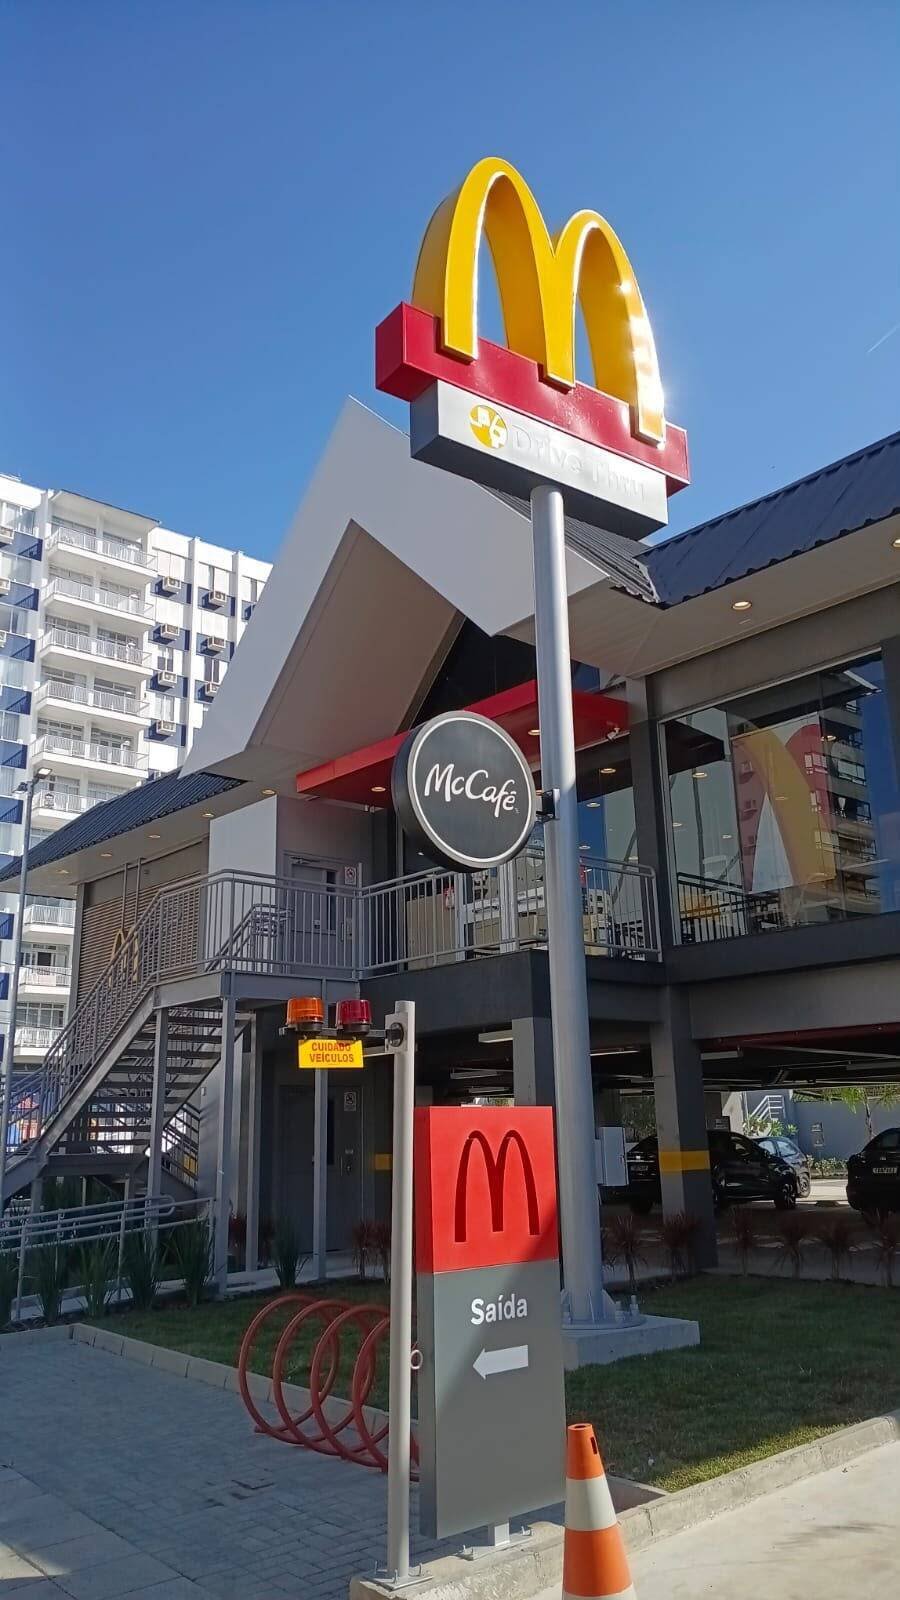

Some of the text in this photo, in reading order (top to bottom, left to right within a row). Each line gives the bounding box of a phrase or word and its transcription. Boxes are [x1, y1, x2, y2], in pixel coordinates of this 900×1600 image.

[424, 763, 517, 818] McCafé
[309, 1052, 355, 1063] VEÍCULOS
[311, 1042, 352, 1052] CUIDADO
[470, 1293, 528, 1325] Saída
